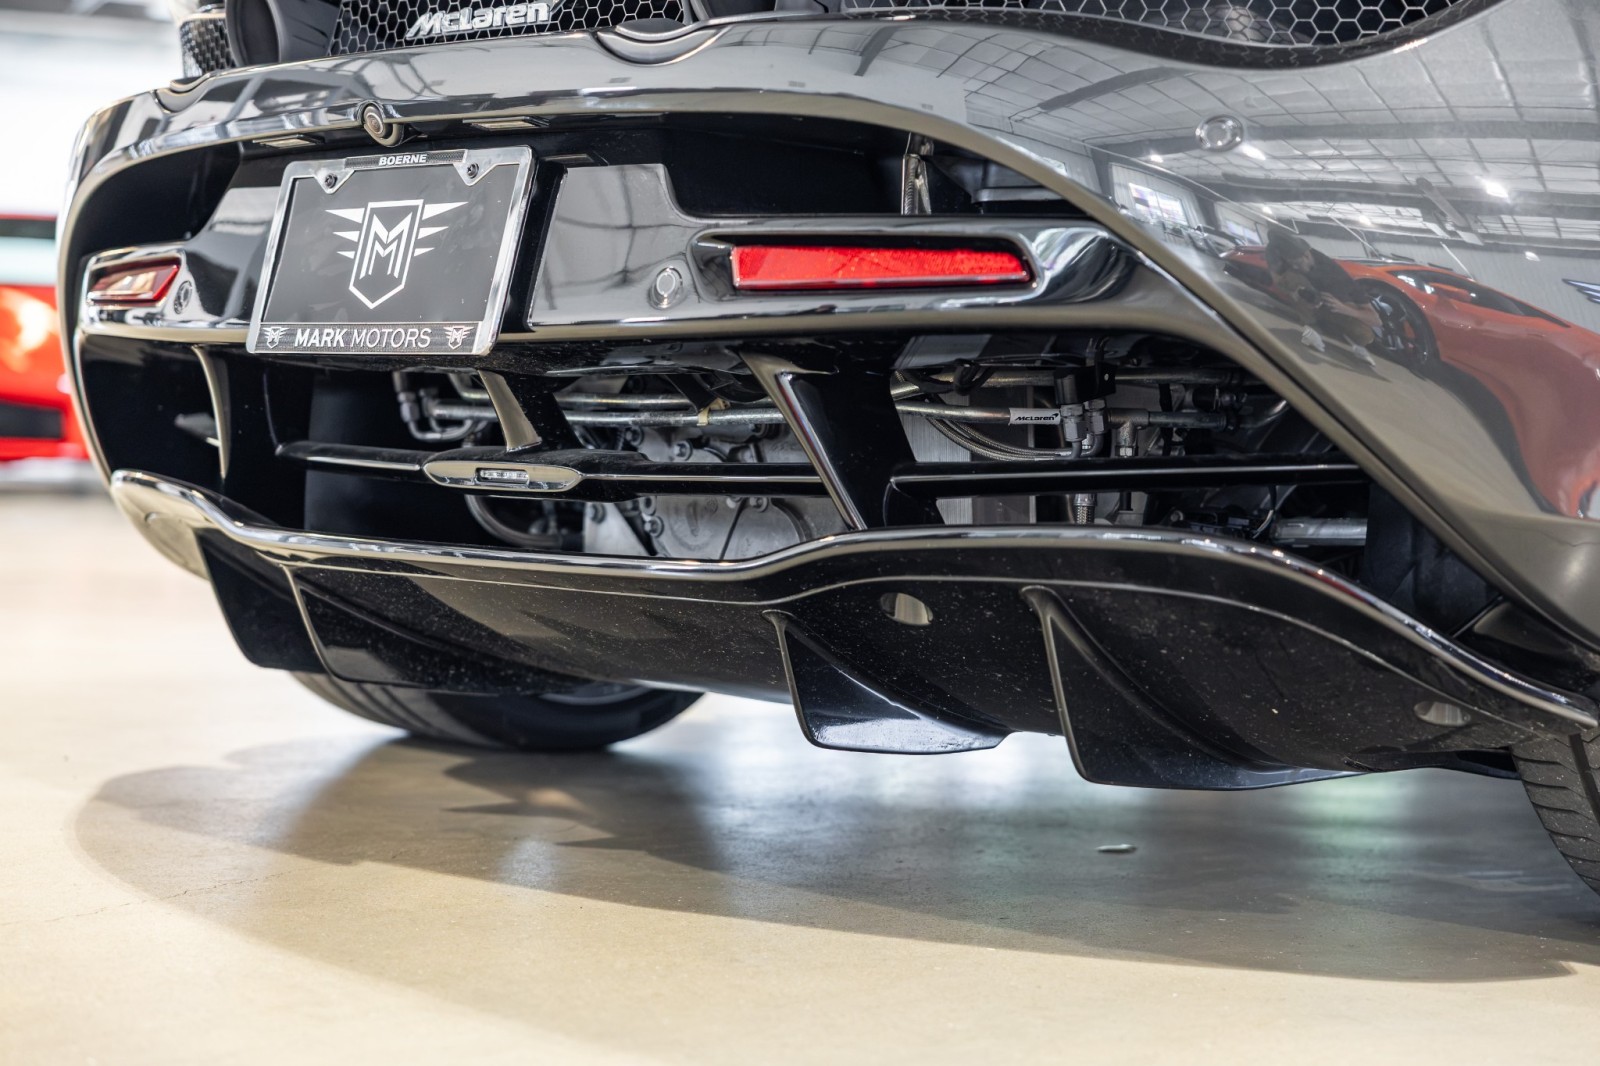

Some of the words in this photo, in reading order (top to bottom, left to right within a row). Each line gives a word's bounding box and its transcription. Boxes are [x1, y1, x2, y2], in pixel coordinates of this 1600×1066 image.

[406, 3, 550, 40] McLaren
[378, 153, 427, 166] BOERNE
[294, 328, 347, 347] MARK
[350, 328, 431, 348] MOTORS
